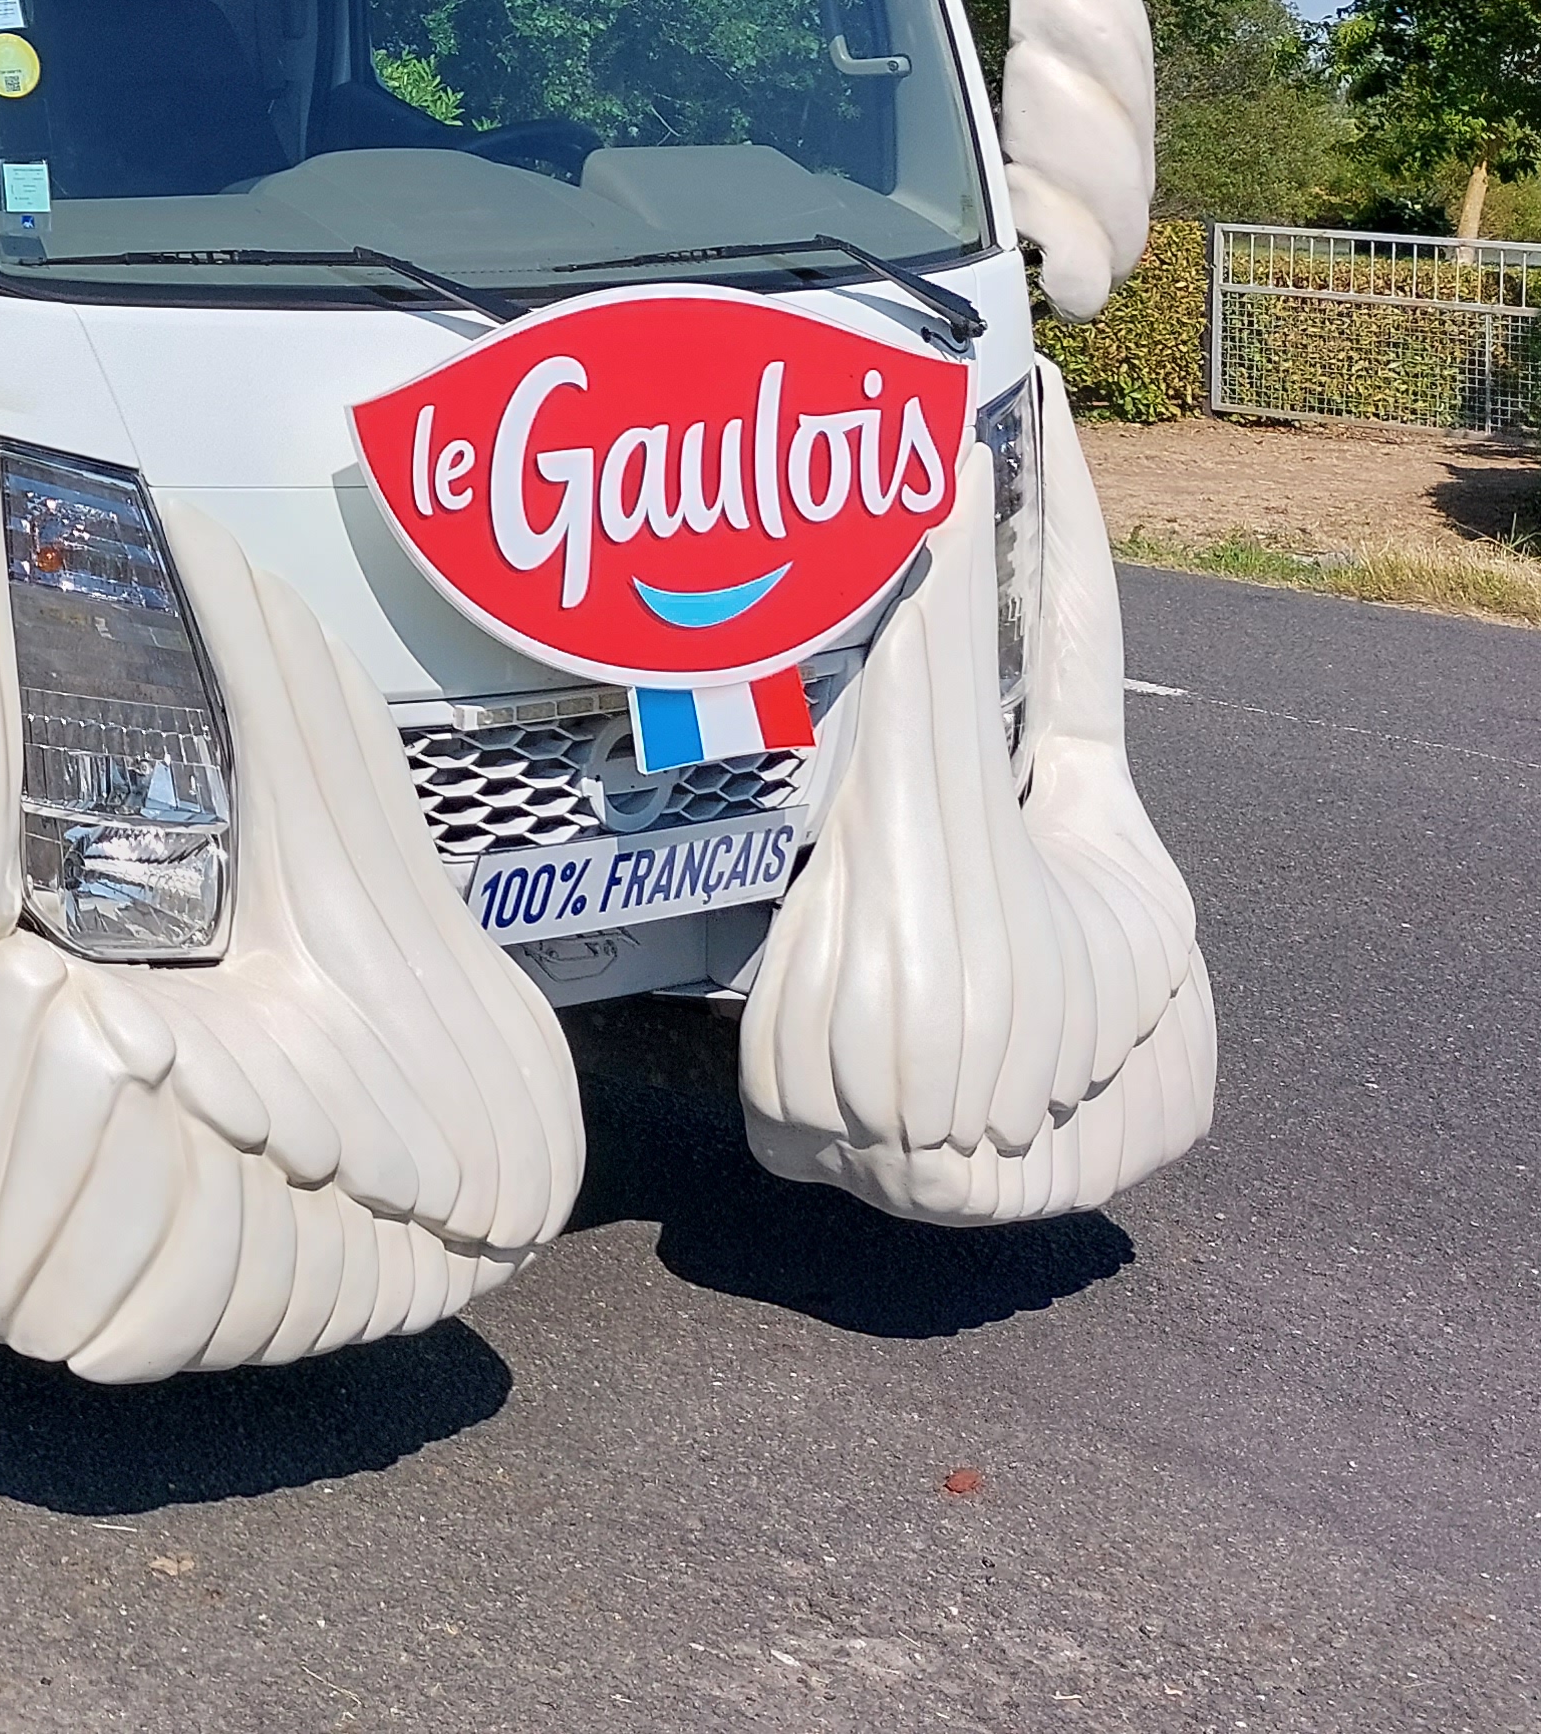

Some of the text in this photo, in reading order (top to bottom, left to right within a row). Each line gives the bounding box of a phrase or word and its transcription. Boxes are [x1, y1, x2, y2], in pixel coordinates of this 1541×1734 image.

[412, 355, 947, 608] le Gaulois
[479, 823, 795, 930] 100% FRANÇAIS
